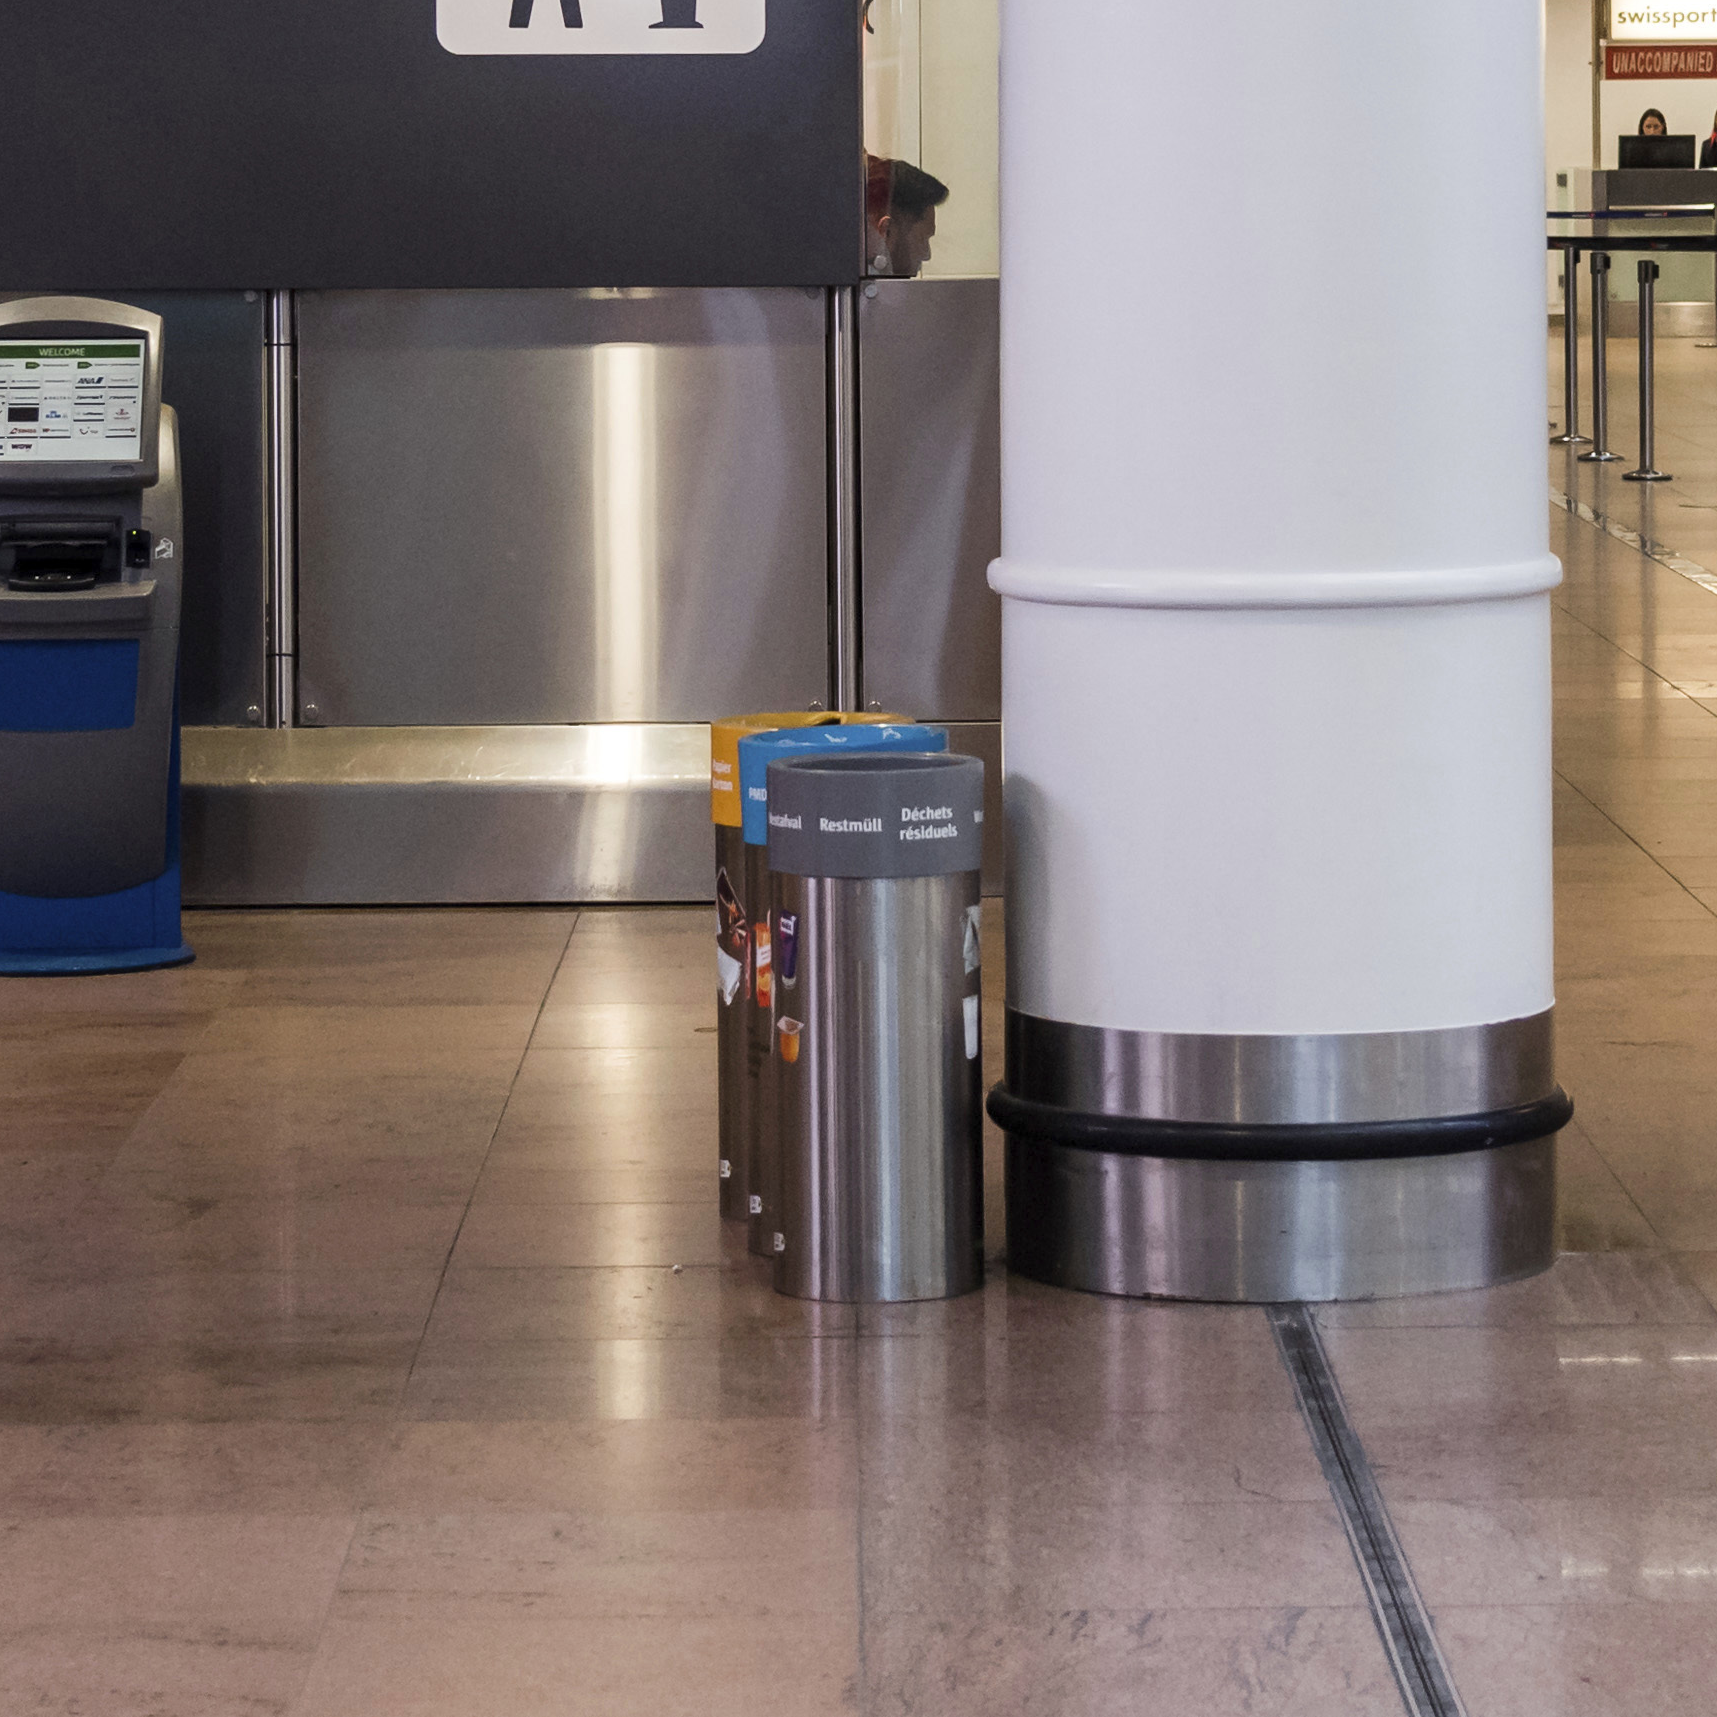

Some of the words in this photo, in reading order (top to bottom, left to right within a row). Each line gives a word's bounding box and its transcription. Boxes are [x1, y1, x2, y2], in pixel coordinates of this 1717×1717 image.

[1617, 5, 1717, 28] swissport
[1612, 51, 1714, 74] UNACCOMPANIED
[39, 347, 86, 356] WELCOME
[901, 806, 953, 822] Déchets
[819, 817, 883, 833] Restmüll
[899, 824, 958, 840] résiduels
